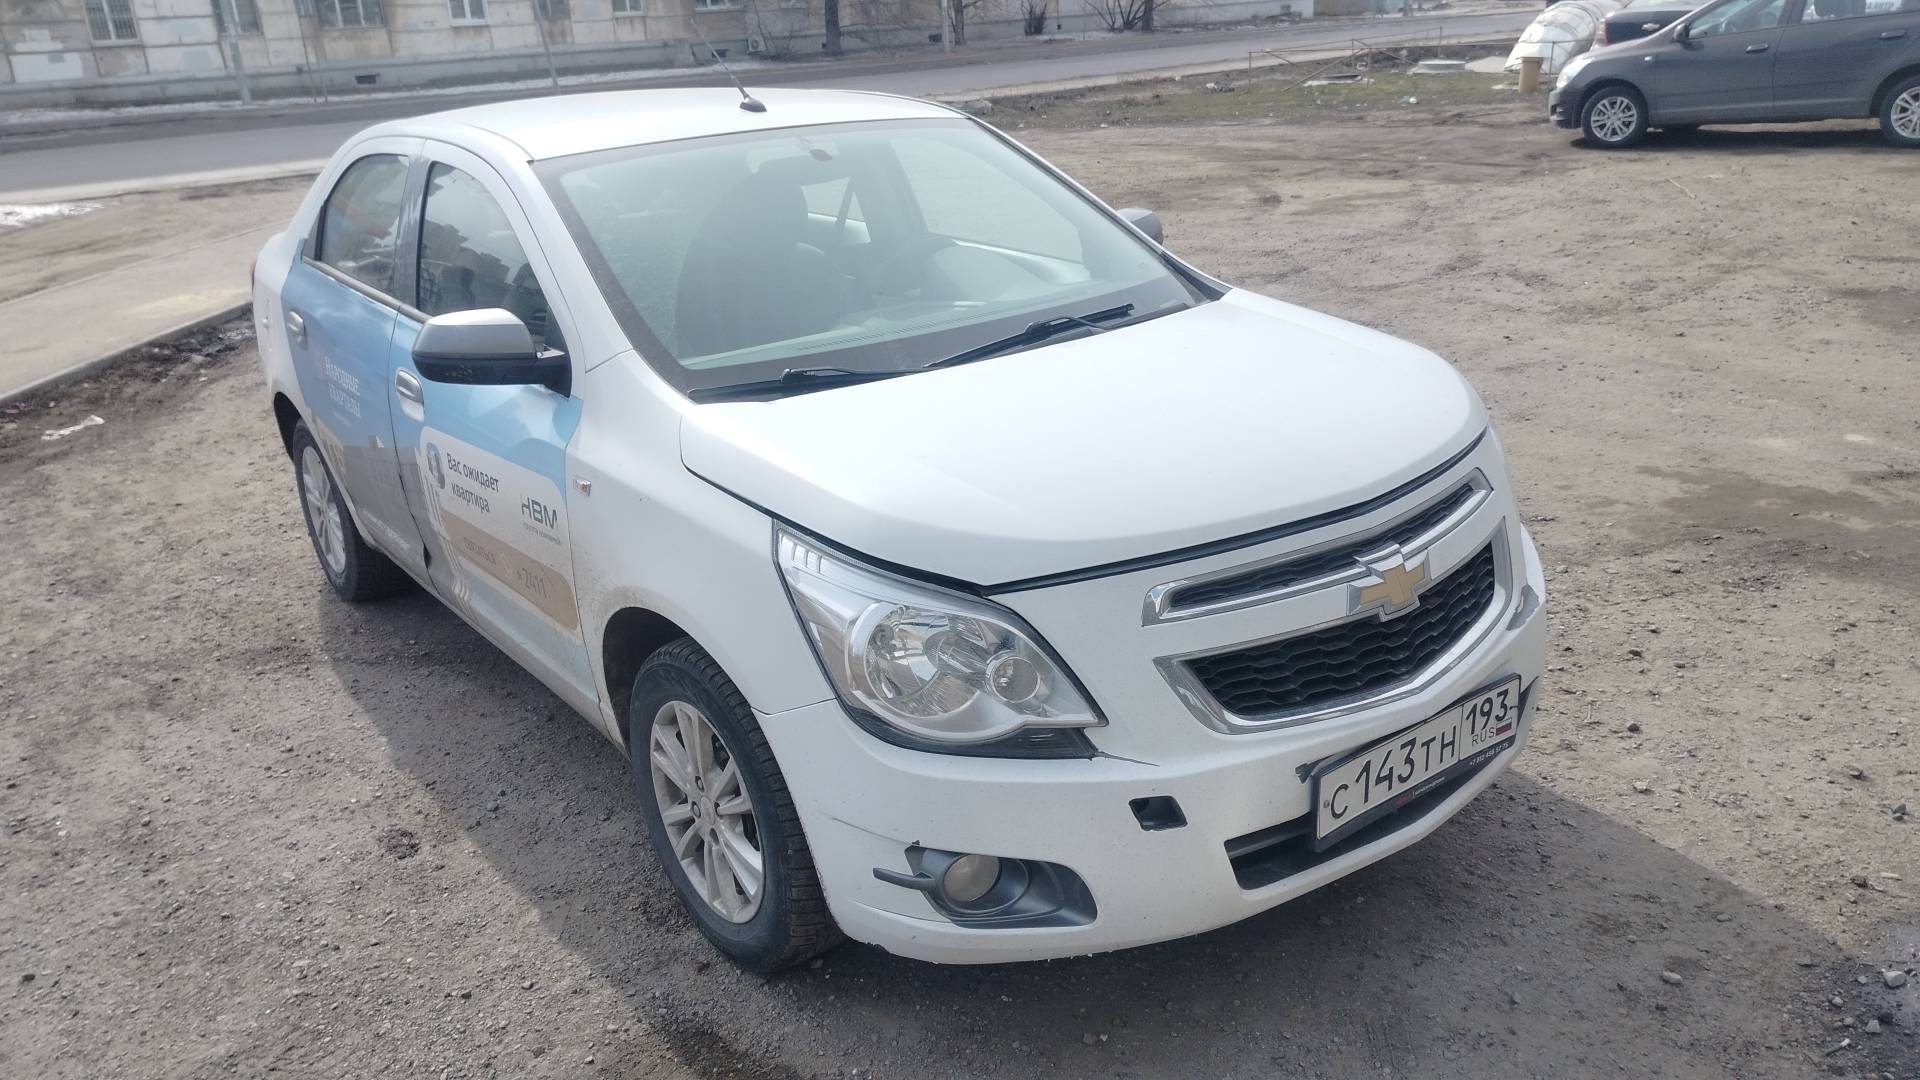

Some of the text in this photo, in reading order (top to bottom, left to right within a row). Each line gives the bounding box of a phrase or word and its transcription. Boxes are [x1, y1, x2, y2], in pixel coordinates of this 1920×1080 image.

[446, 453, 499, 492] Вас ожидает
[451, 482, 490, 514] квартира
[1465, 688, 1511, 735] 193
[1471, 726, 1496, 747] RUS
